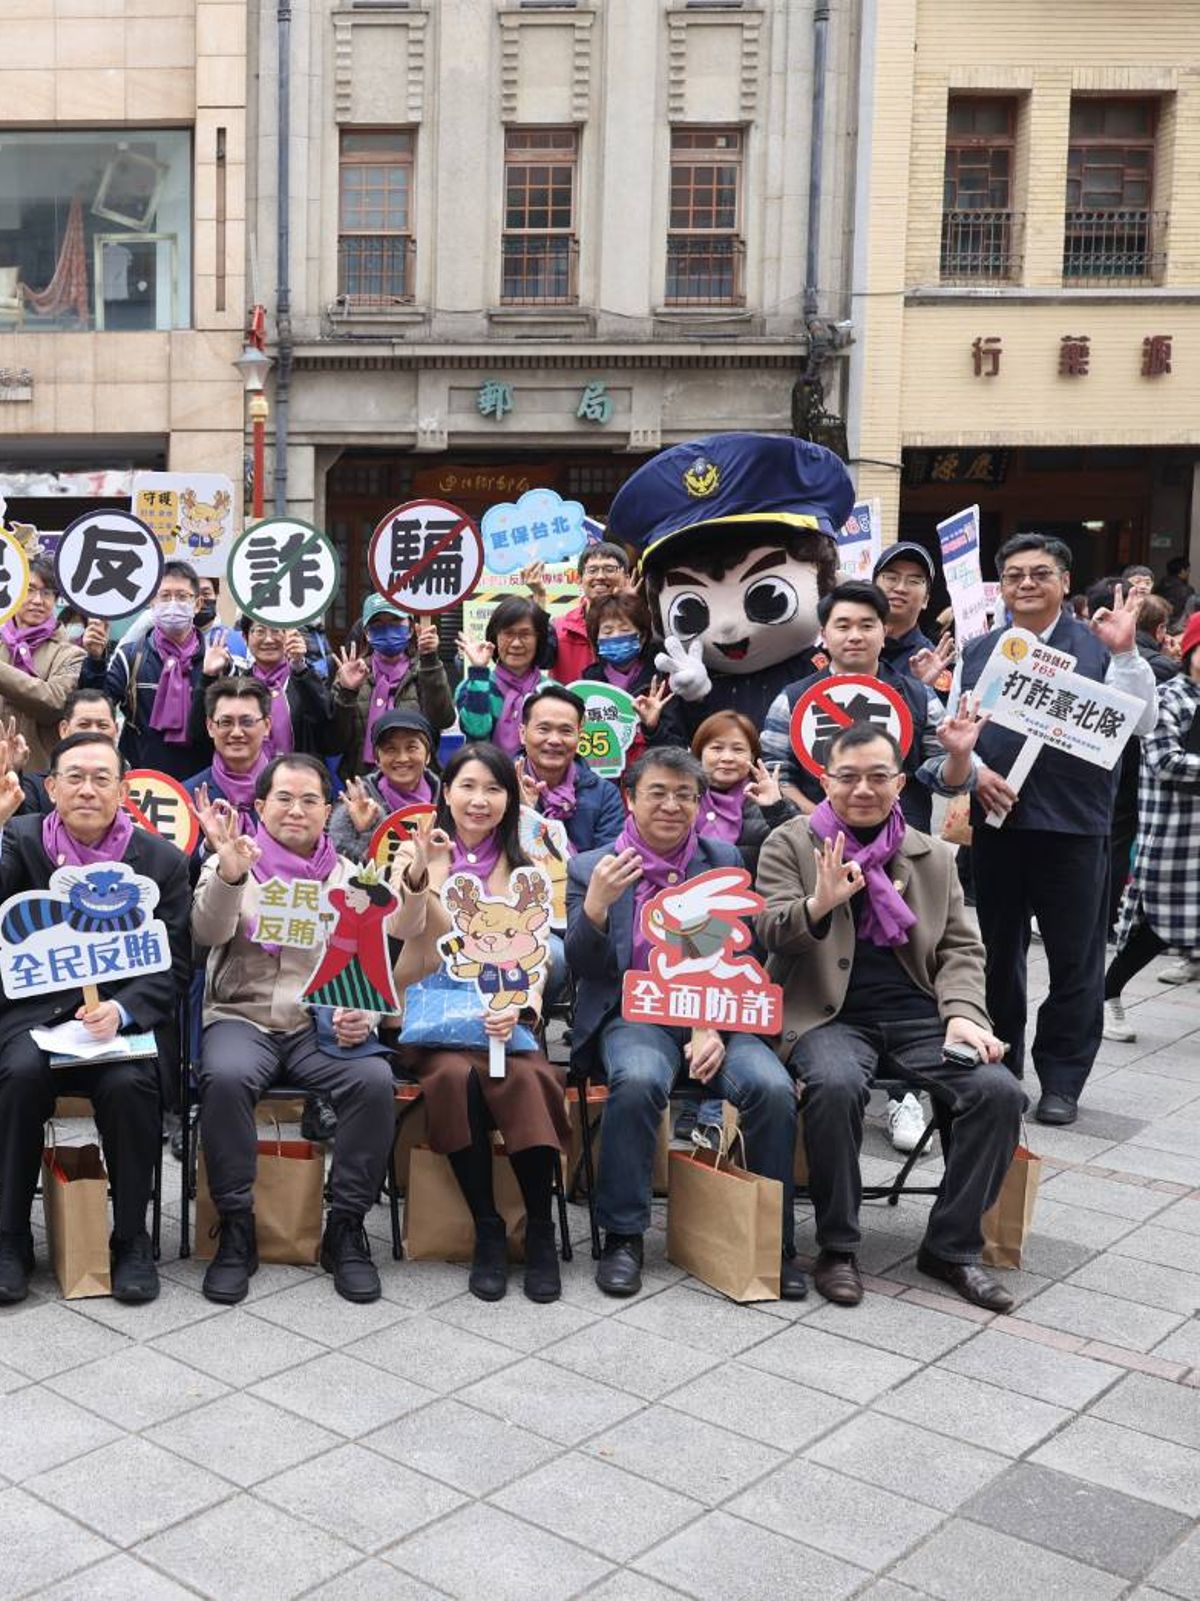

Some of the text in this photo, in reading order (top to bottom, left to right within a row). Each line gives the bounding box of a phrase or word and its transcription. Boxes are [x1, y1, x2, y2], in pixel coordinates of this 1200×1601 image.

[477, 378, 614, 424] 郵局
[143, 491, 172, 507] 守護
[71, 525, 148, 602] 反
[245, 532, 324, 609] 詐
[387, 518, 464, 596] 騙
[586, 705, 619, 722] 專線
[1002, 670, 1126, 739] 打詐臺北隊
[576, 730, 611, 758] 65
[259, 879, 320, 908] 全民
[257, 912, 316, 945] 反賄
[10, 932, 162, 990] 全民反賄
[630, 979, 776, 1028] 全面防詐
